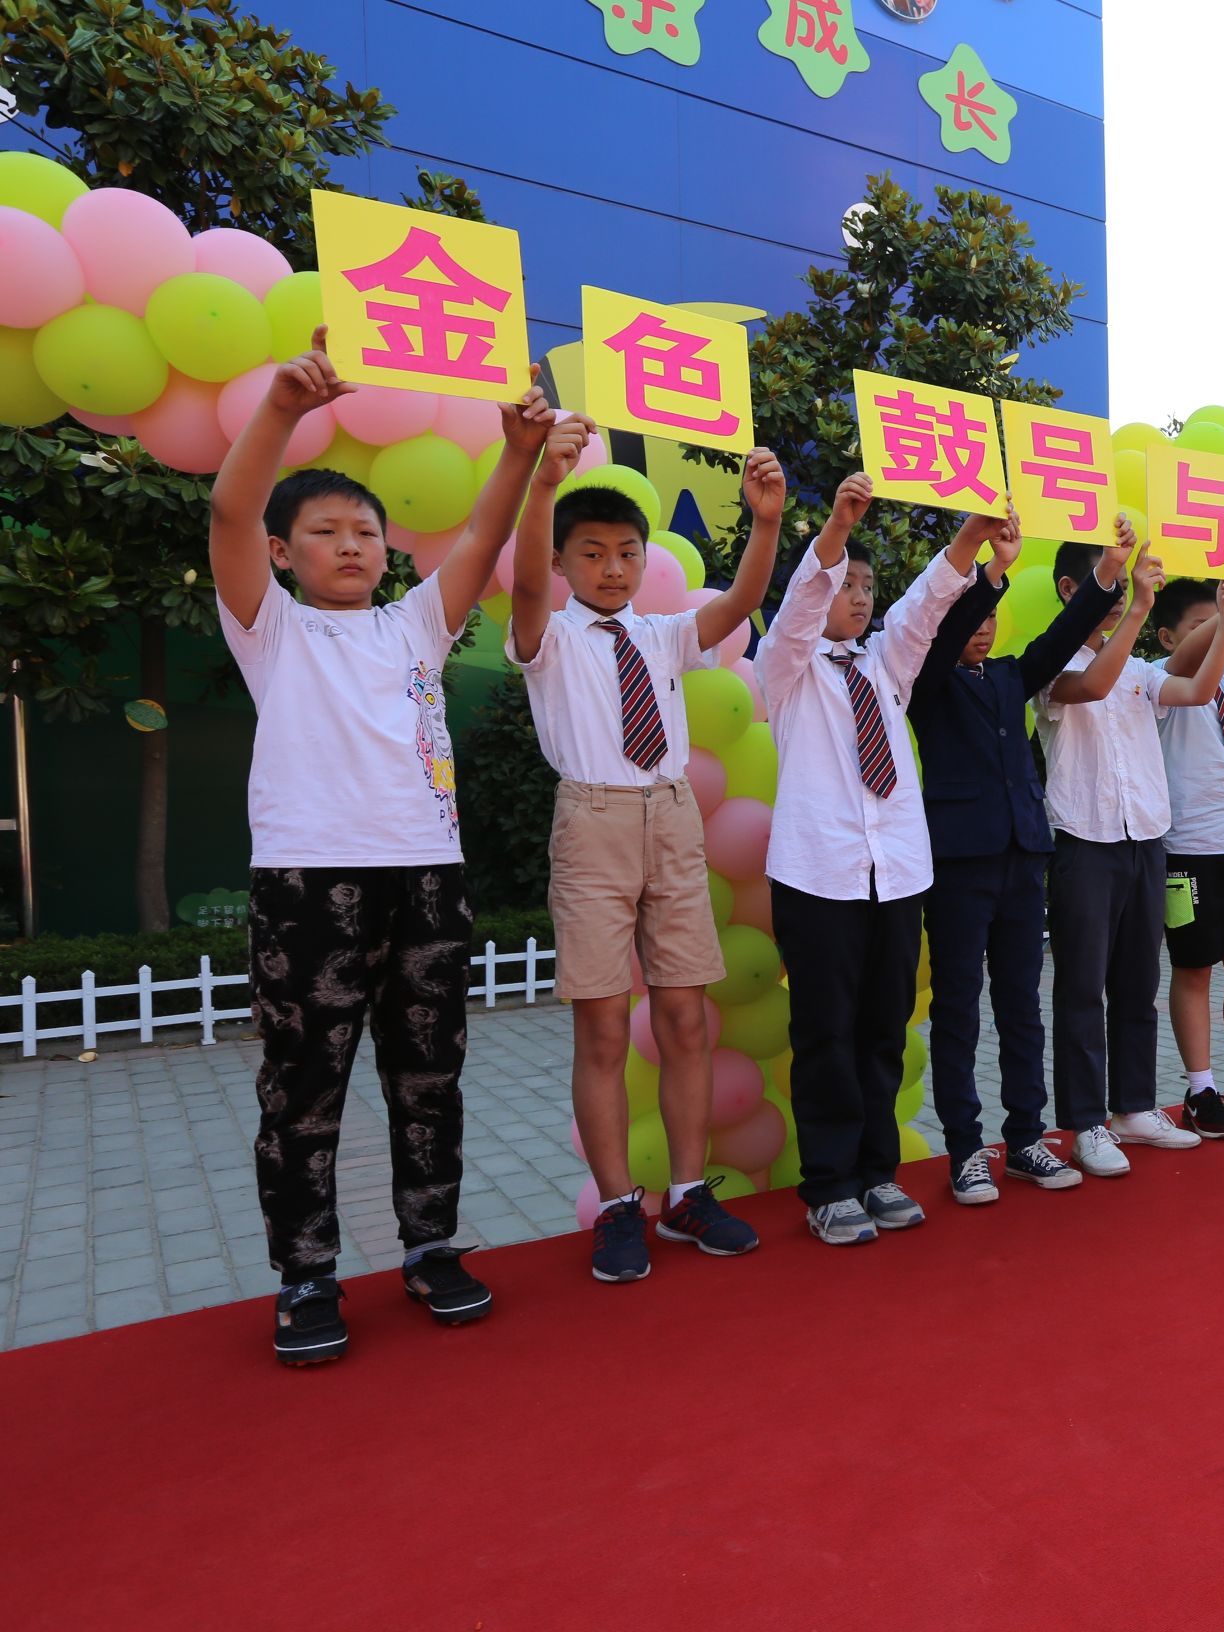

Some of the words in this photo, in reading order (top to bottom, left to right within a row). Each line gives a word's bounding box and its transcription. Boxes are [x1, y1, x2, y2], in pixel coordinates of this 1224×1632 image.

[340, 225, 513, 385] 金
[602, 311, 741, 437] 色
[873, 388, 1000, 506] 鼓
[1020, 422, 1109, 532] 号
[1190, 877, 1200, 905] POPULAR
